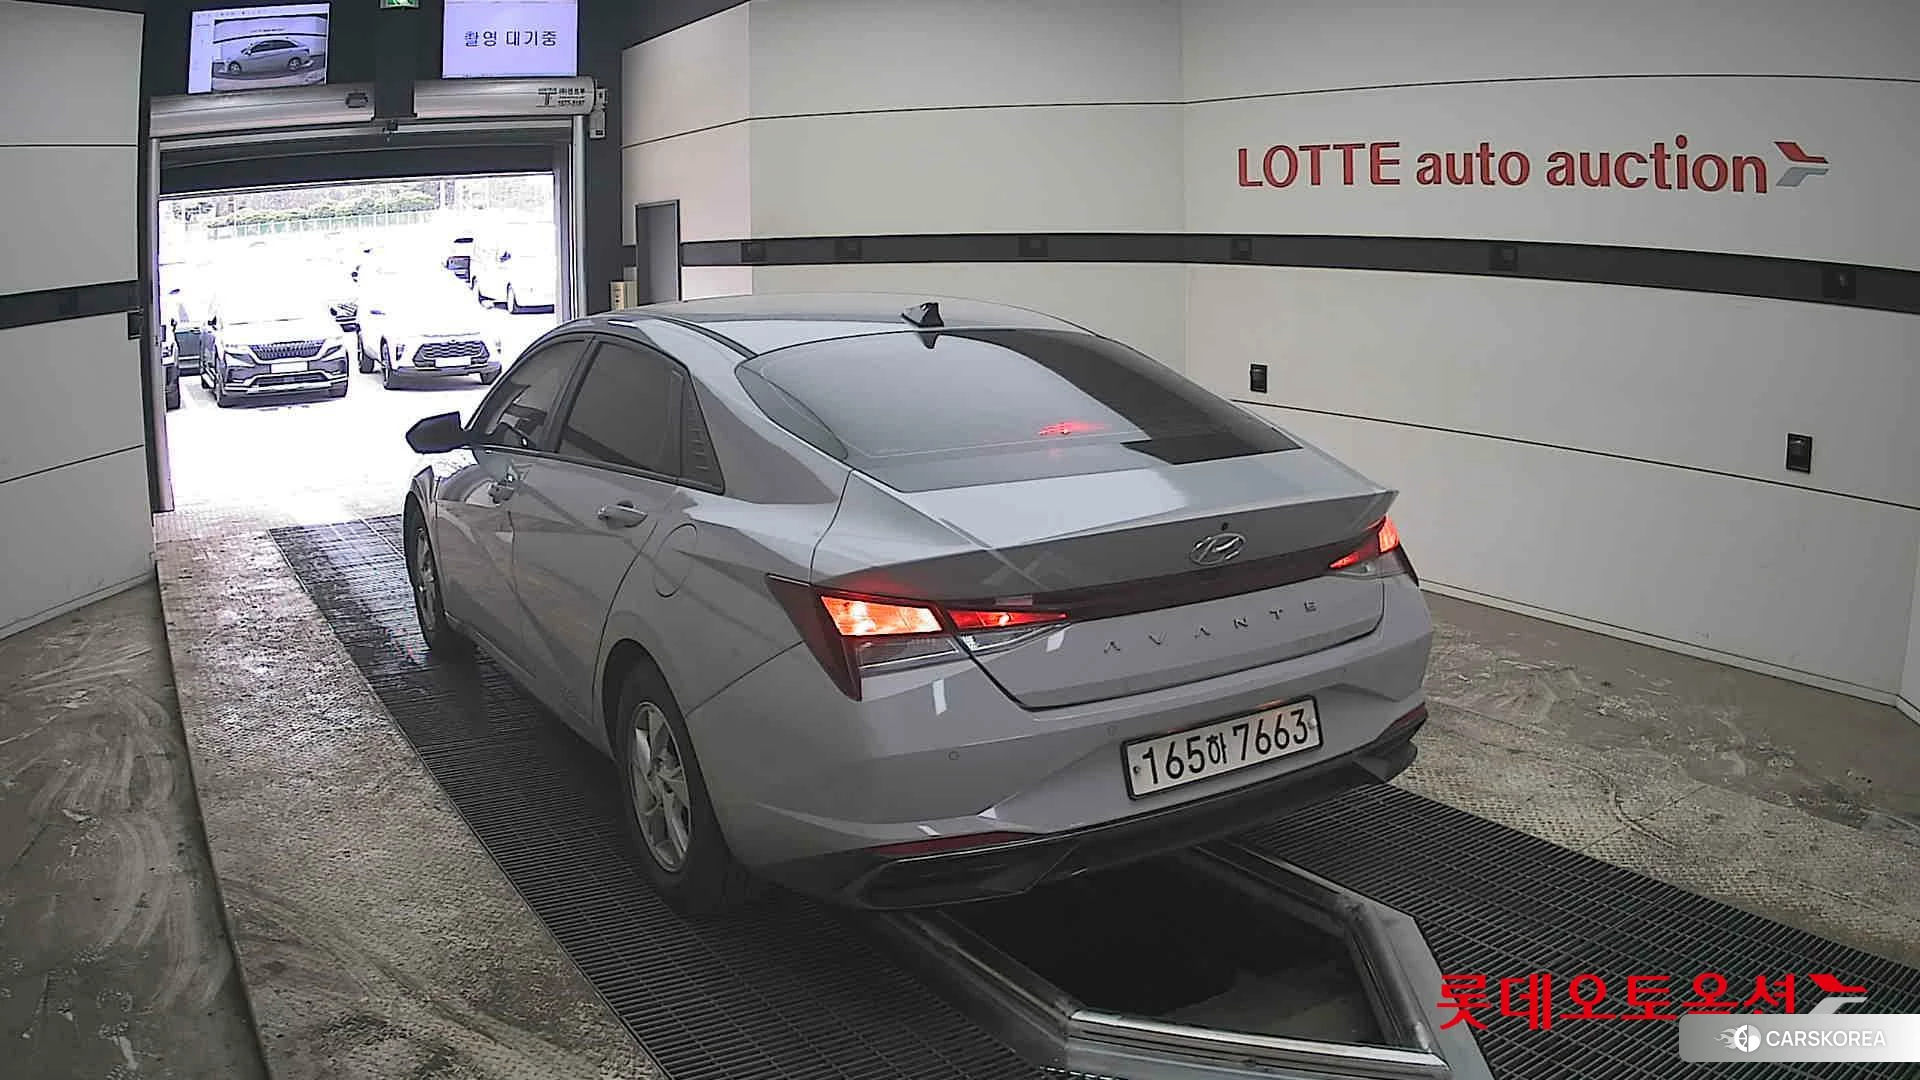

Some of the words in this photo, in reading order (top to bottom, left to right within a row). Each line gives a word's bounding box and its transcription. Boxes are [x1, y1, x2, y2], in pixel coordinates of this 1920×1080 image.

[505, 30, 558, 47] 대기중
[1238, 141, 1401, 188] LOTTE
[1415, 142, 1531, 187] auto
[1546, 135, 1768, 194] auction
[1103, 600, 1318, 654] AVANTE
[1142, 731, 1228, 785] 165하
[1232, 708, 1309, 762] 7663
